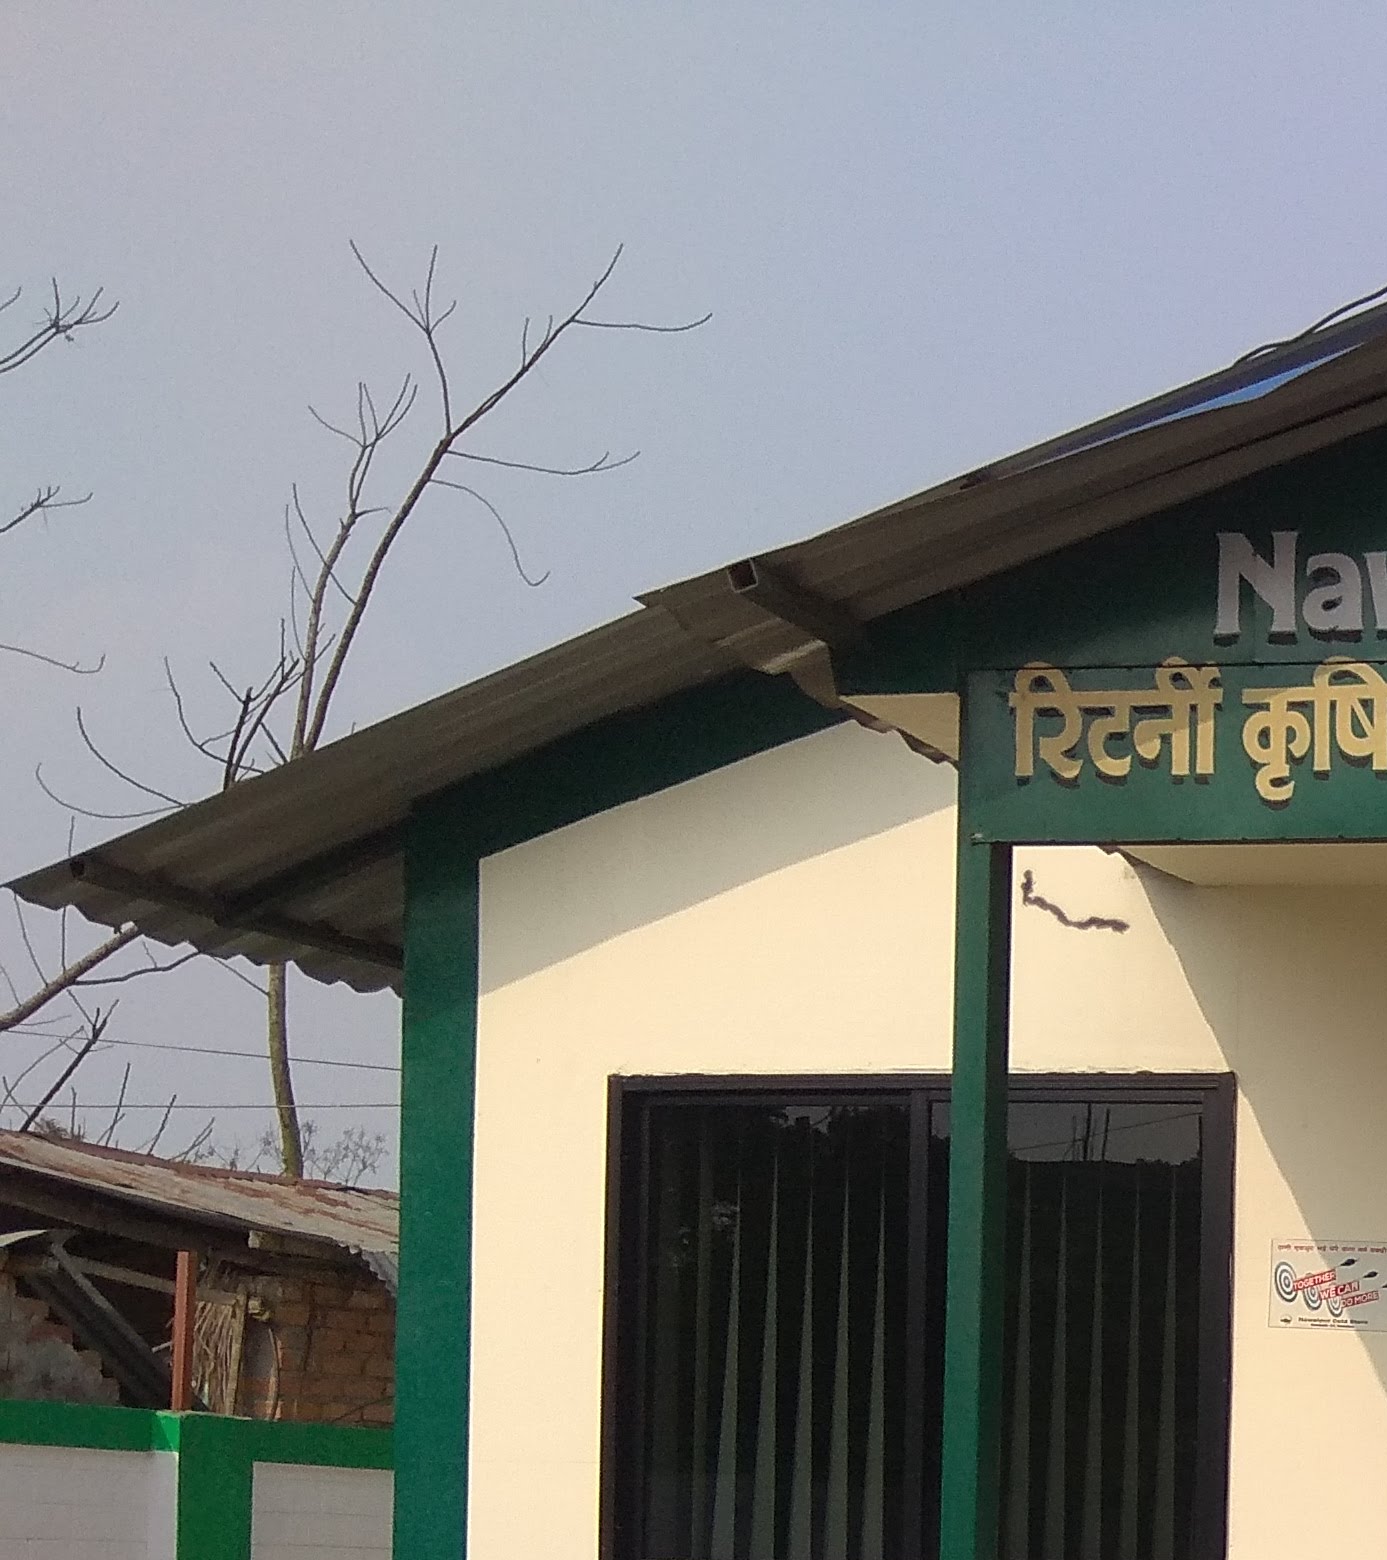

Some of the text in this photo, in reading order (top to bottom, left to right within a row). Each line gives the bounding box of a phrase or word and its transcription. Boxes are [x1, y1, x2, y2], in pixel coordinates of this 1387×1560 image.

[1319, 1287, 1336, 1300] WE
[1341, 1292, 1378, 1308] DO MORE
